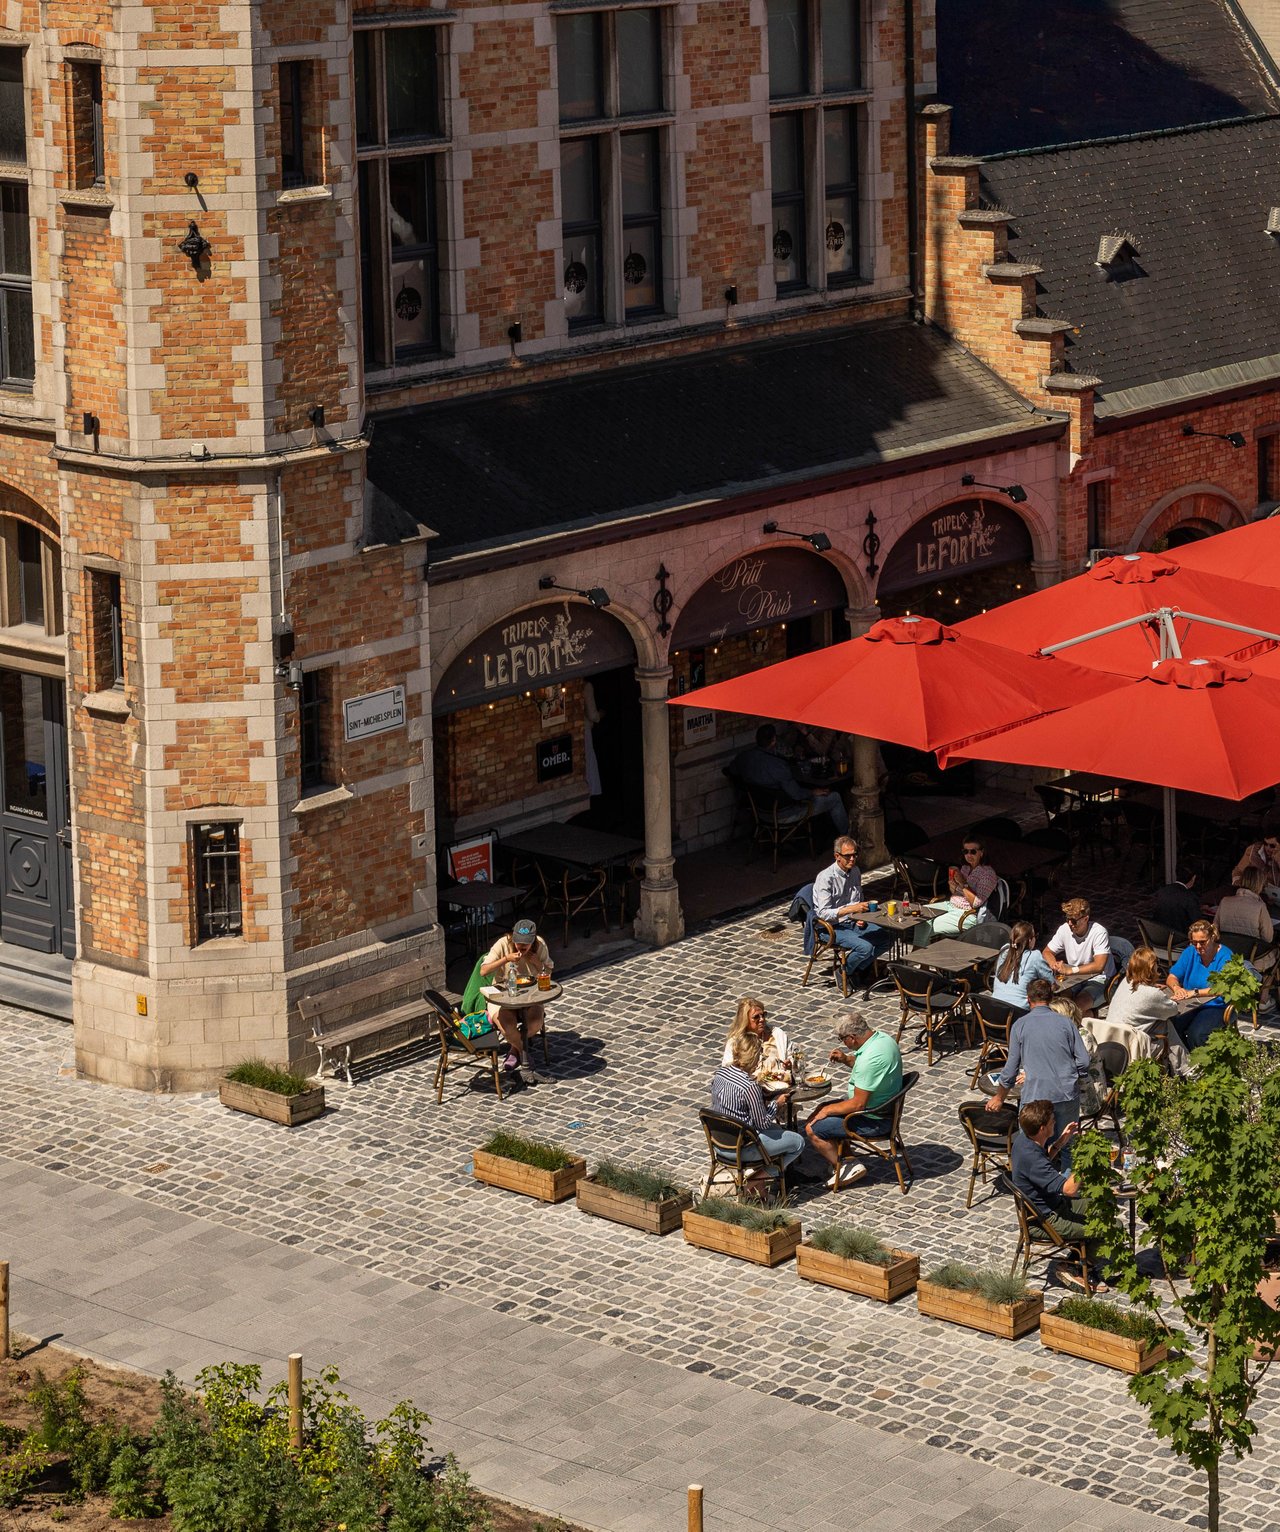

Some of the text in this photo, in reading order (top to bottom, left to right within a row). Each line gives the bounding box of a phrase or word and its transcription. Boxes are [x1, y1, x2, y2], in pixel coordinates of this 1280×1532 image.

[932, 514, 963, 537] TRIPEL
[713, 558, 767, 593] Petit
[738, 584, 792, 625] Paris
[502, 620, 541, 646] TRIPEL
[348, 707, 402, 731] SINT-MICHIELSPLEIN
[686, 712, 714, 731] MARTHA
[542, 751, 571, 768] OMER.
